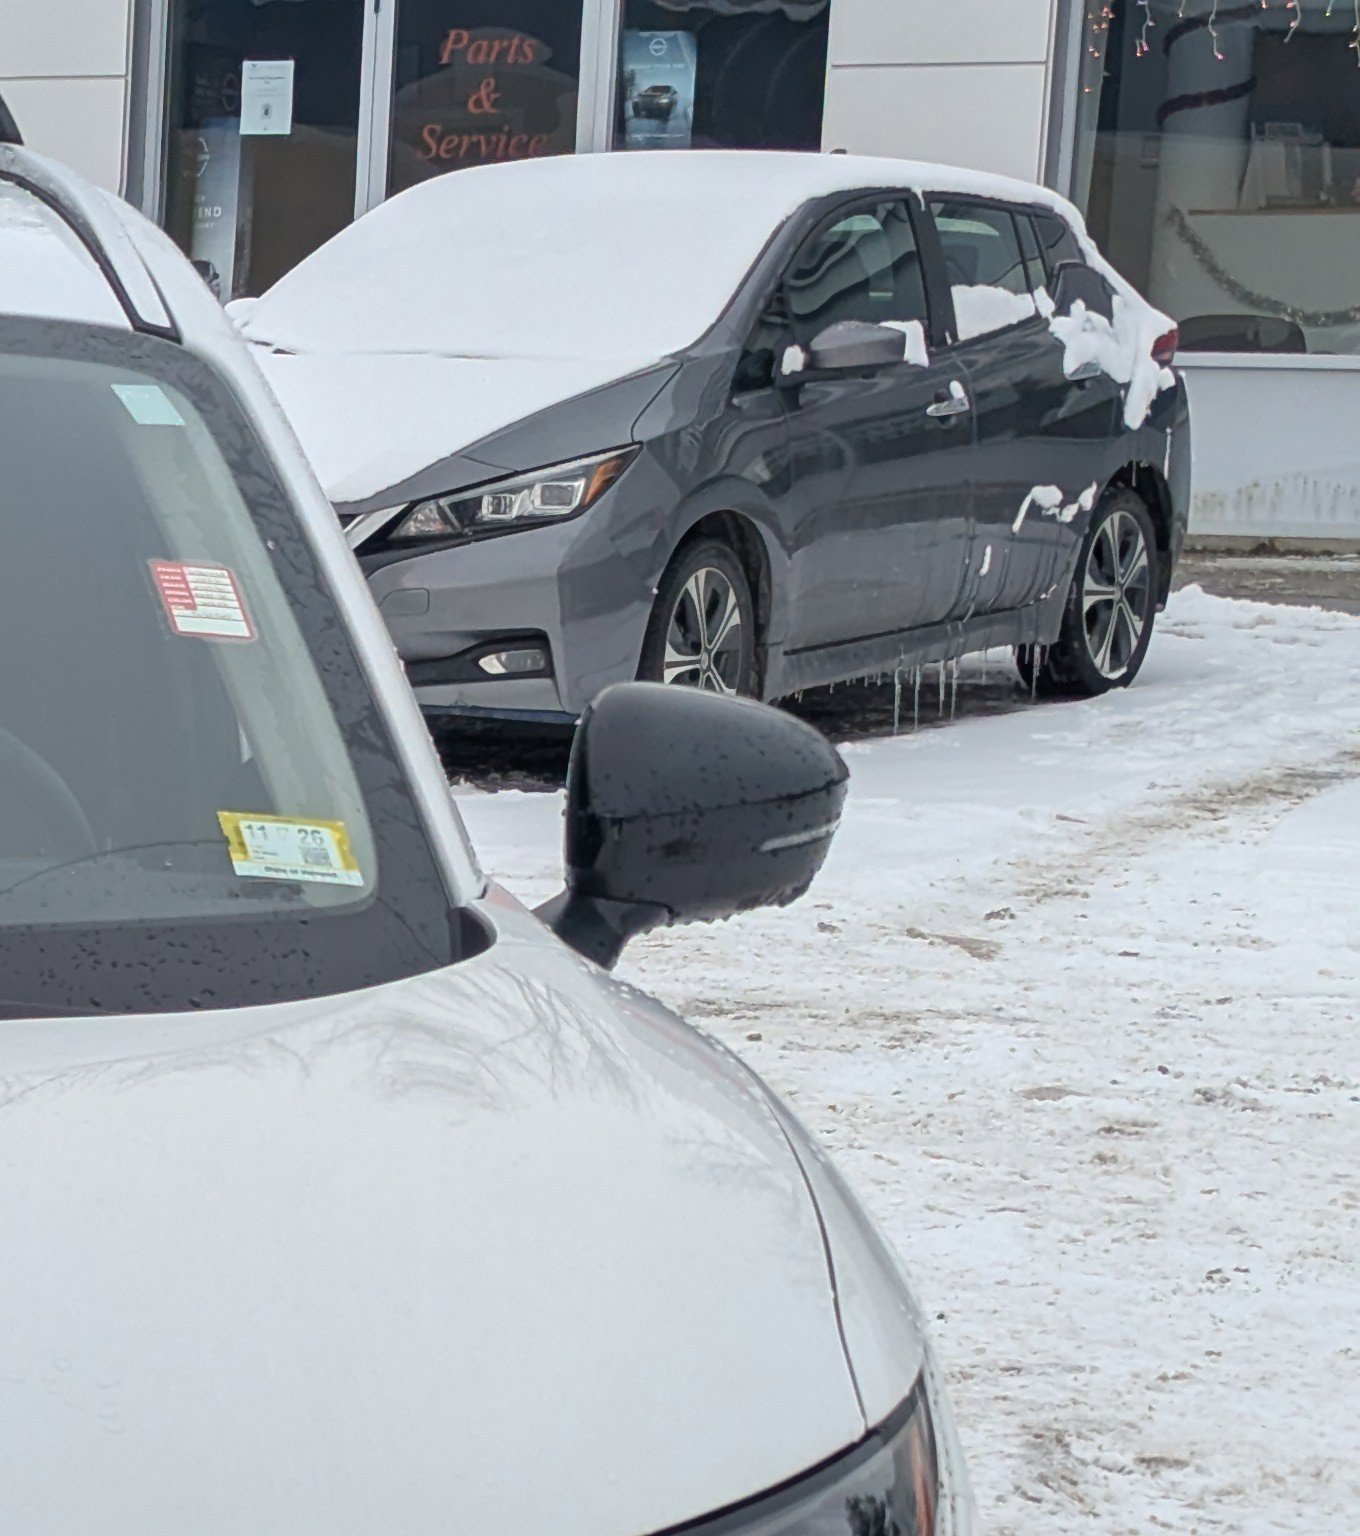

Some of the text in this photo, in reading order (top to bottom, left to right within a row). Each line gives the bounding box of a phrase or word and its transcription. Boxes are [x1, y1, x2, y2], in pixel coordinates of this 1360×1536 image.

[439, 29, 539, 64] Parts
[467, 77, 502, 114] &
[418, 124, 549, 159] Service
